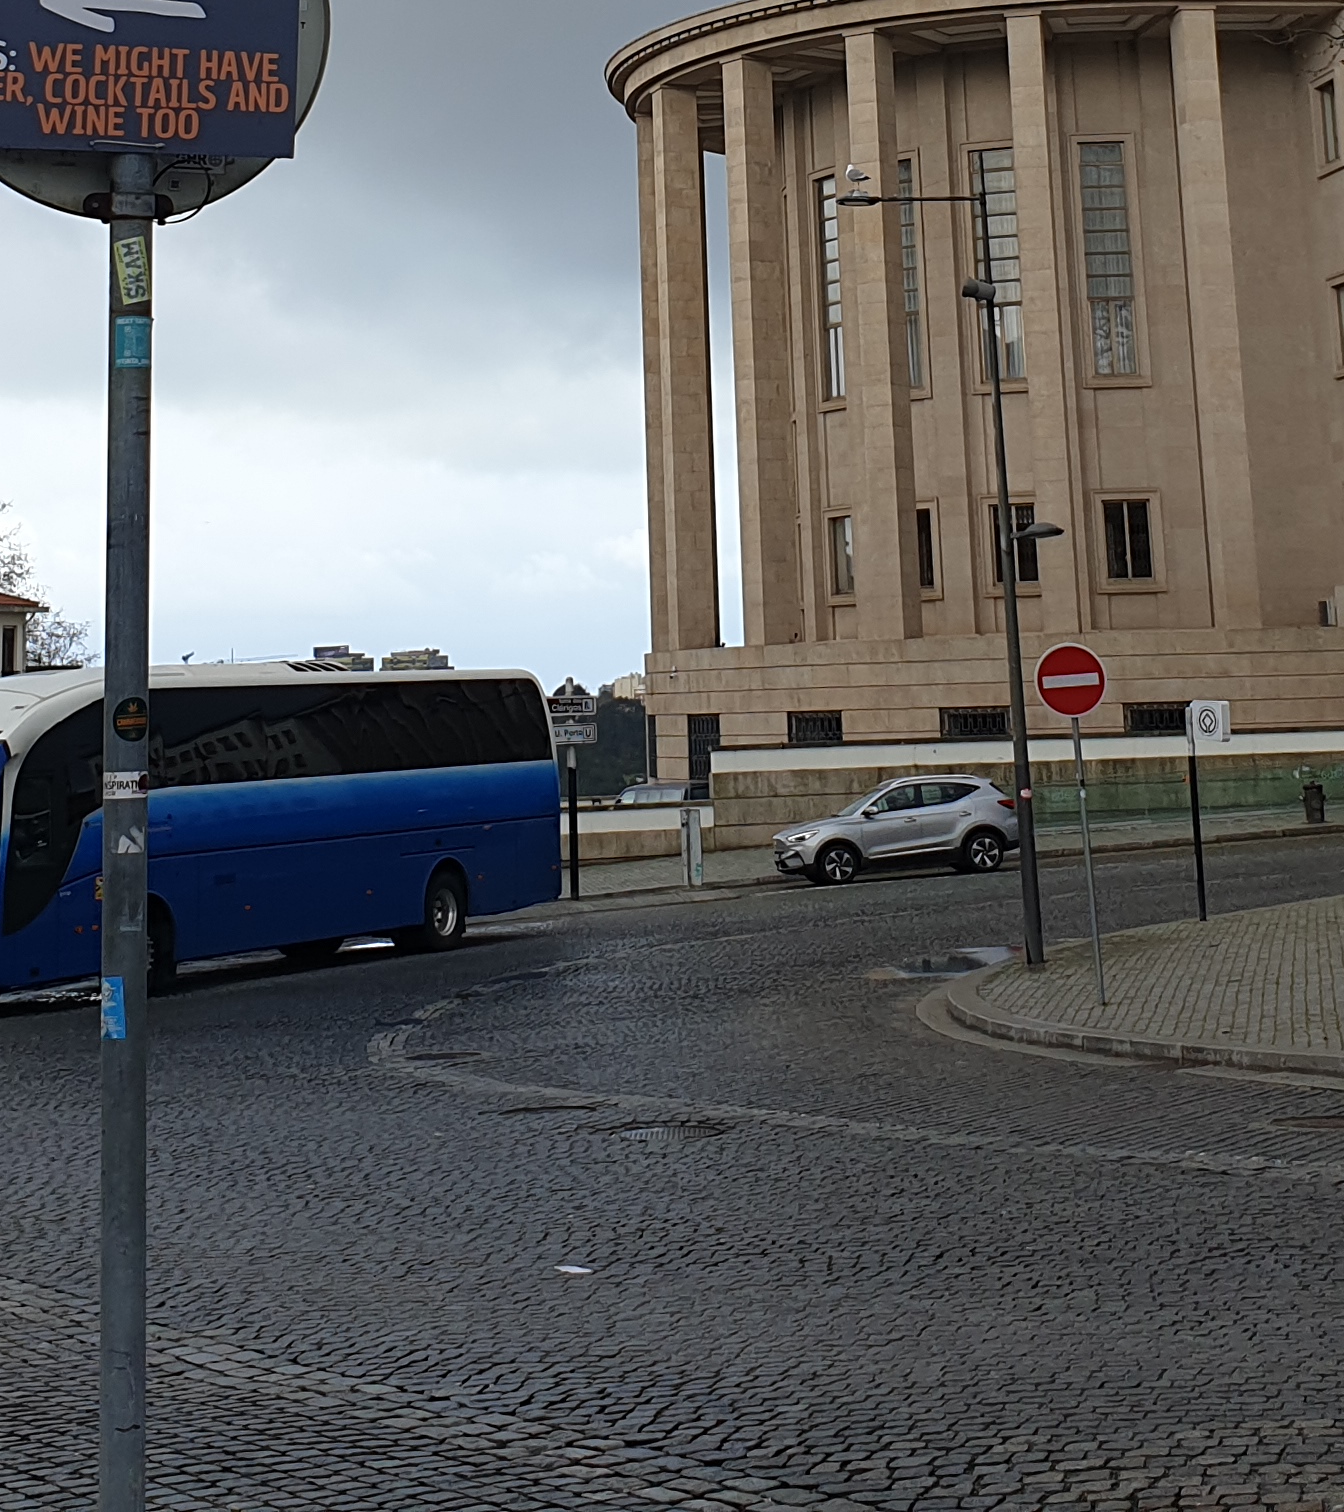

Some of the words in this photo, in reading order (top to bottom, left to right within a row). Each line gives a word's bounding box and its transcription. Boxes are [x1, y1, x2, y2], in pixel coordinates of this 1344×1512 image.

[29, 41, 83, 74] WE
[94, 44, 190, 79] MIGHT
[200, 49, 280, 82] HAVE
[44, 73, 217, 111] COCKTAILS
[227, 82, 289, 113] AND
[36, 103, 125, 137] WINE
[136, 107, 200, 140] TOO
